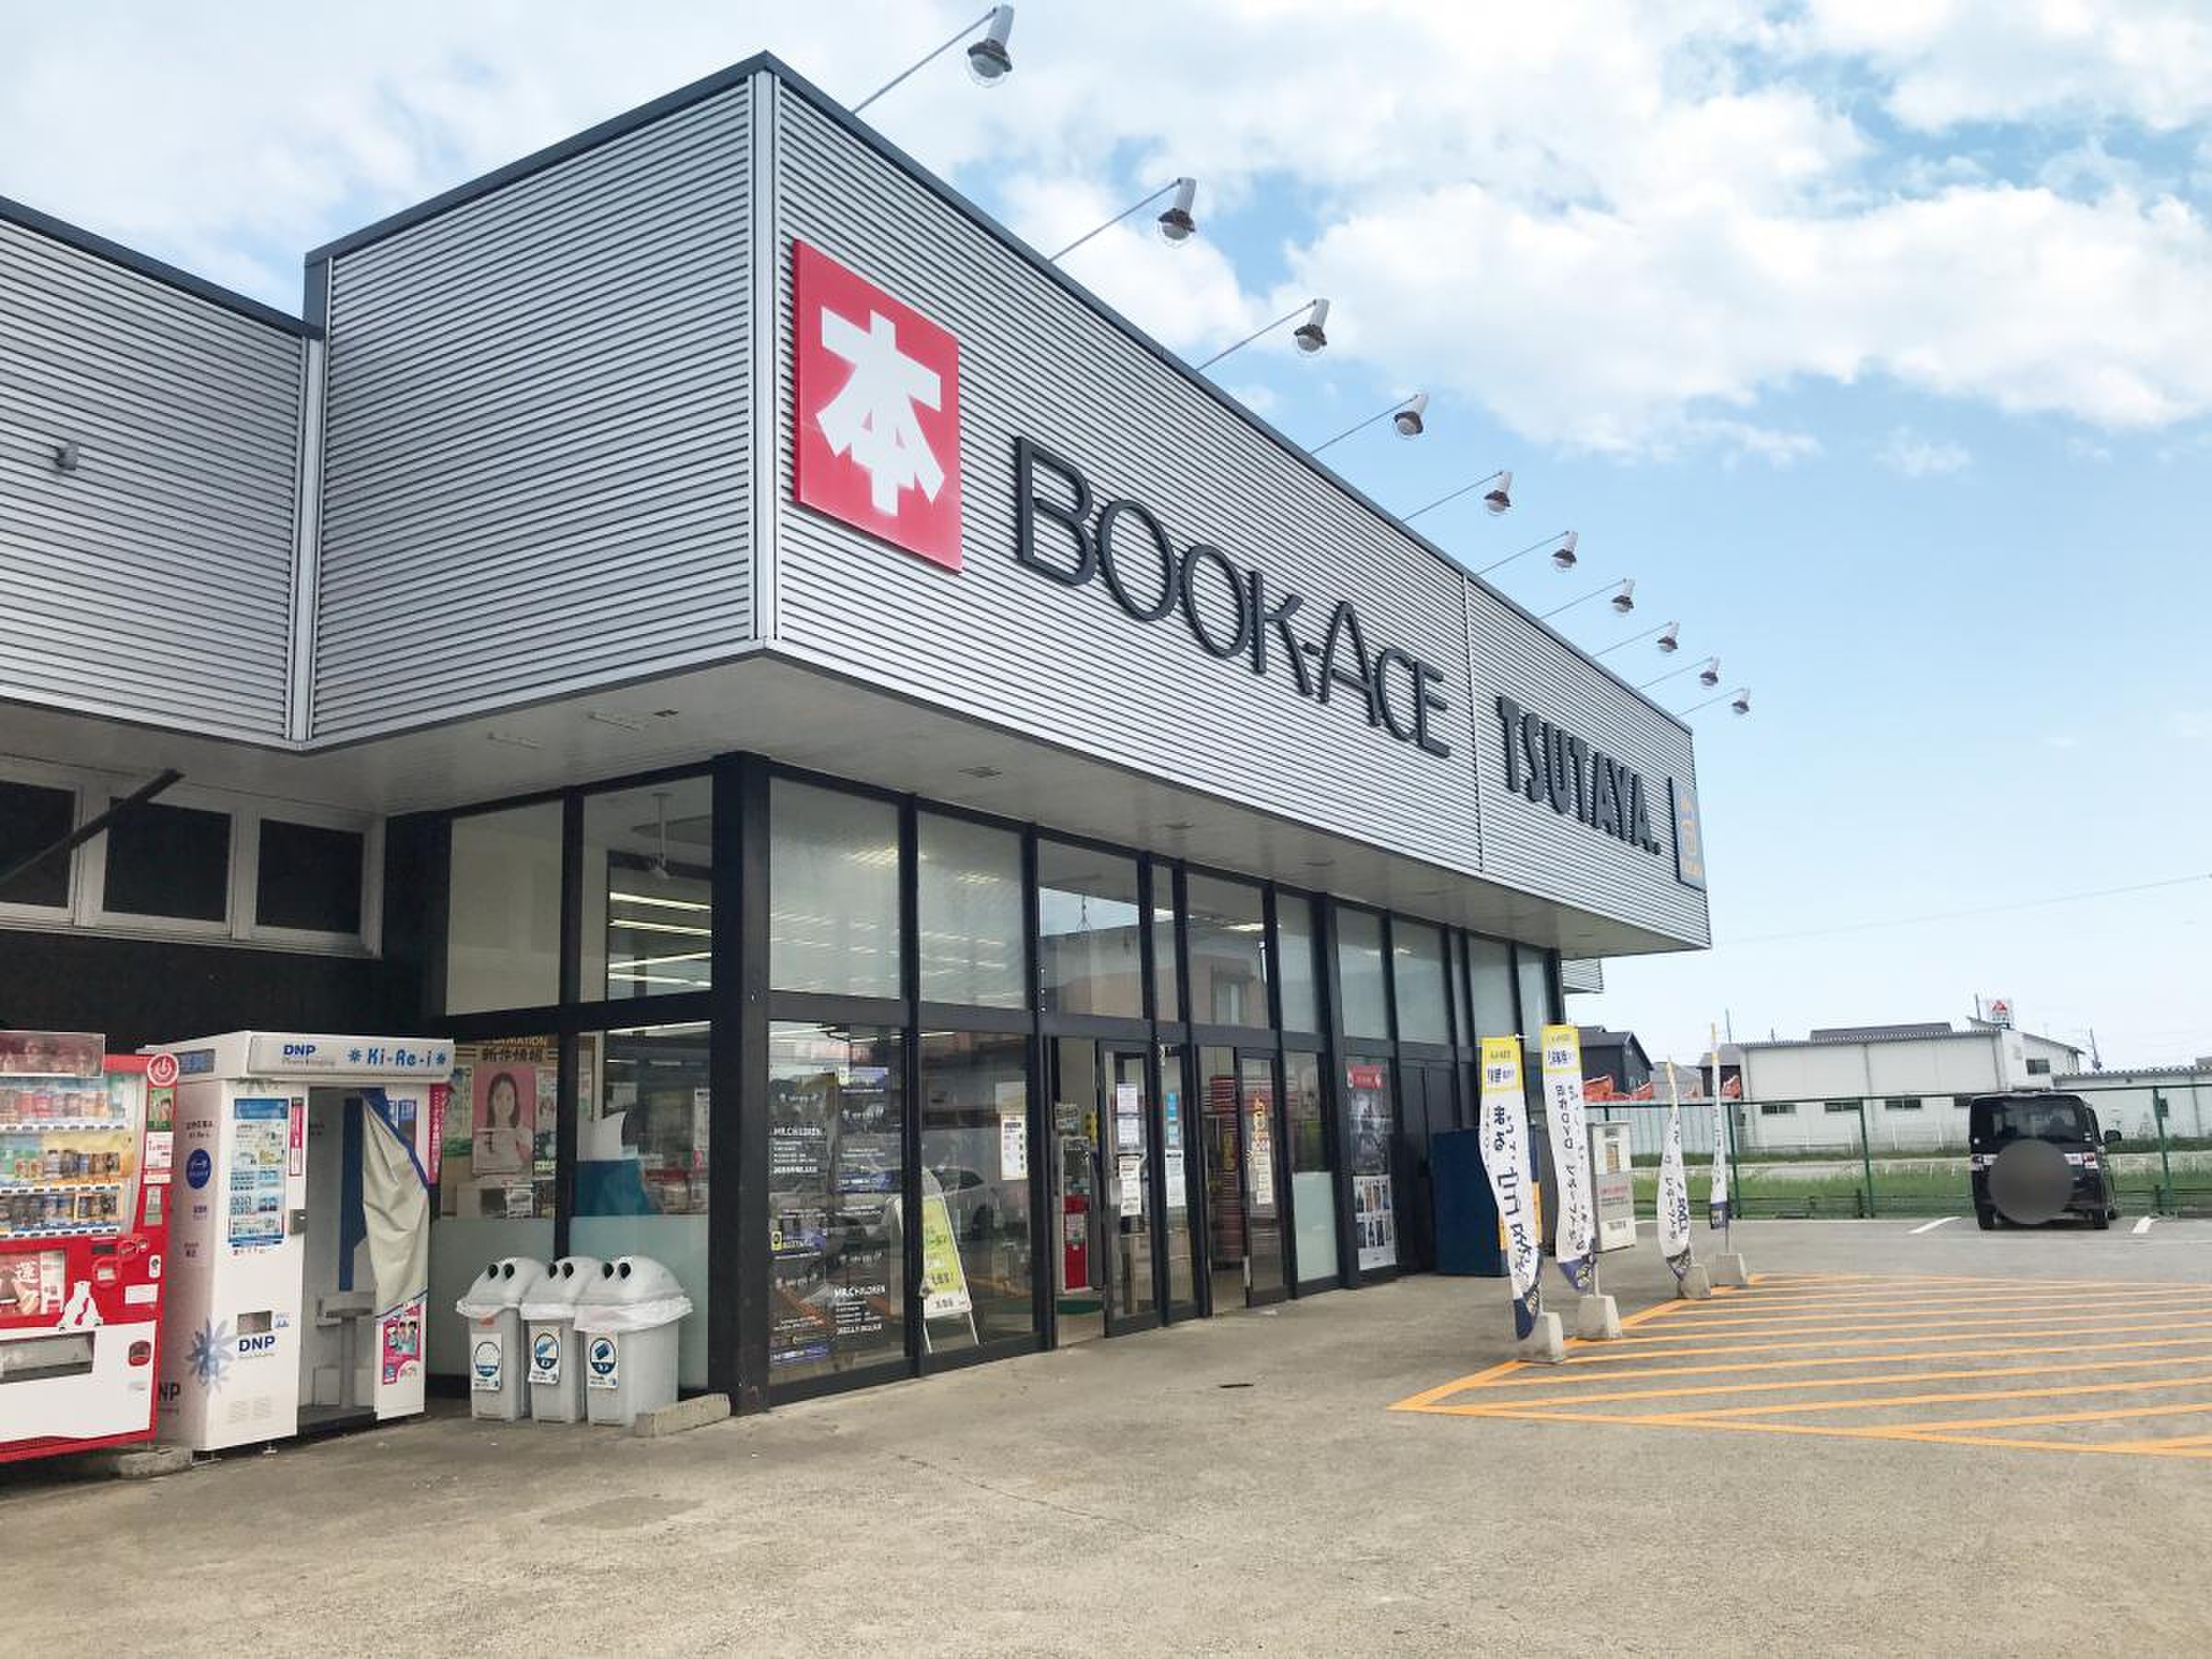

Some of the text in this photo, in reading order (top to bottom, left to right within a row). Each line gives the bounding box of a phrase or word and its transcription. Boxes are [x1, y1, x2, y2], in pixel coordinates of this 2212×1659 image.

[815, 305, 945, 517] 本
[283, 1044, 317, 1057] DNP
[238, 1335, 276, 1353] DNP
[158, 1382, 182, 1402] NP
